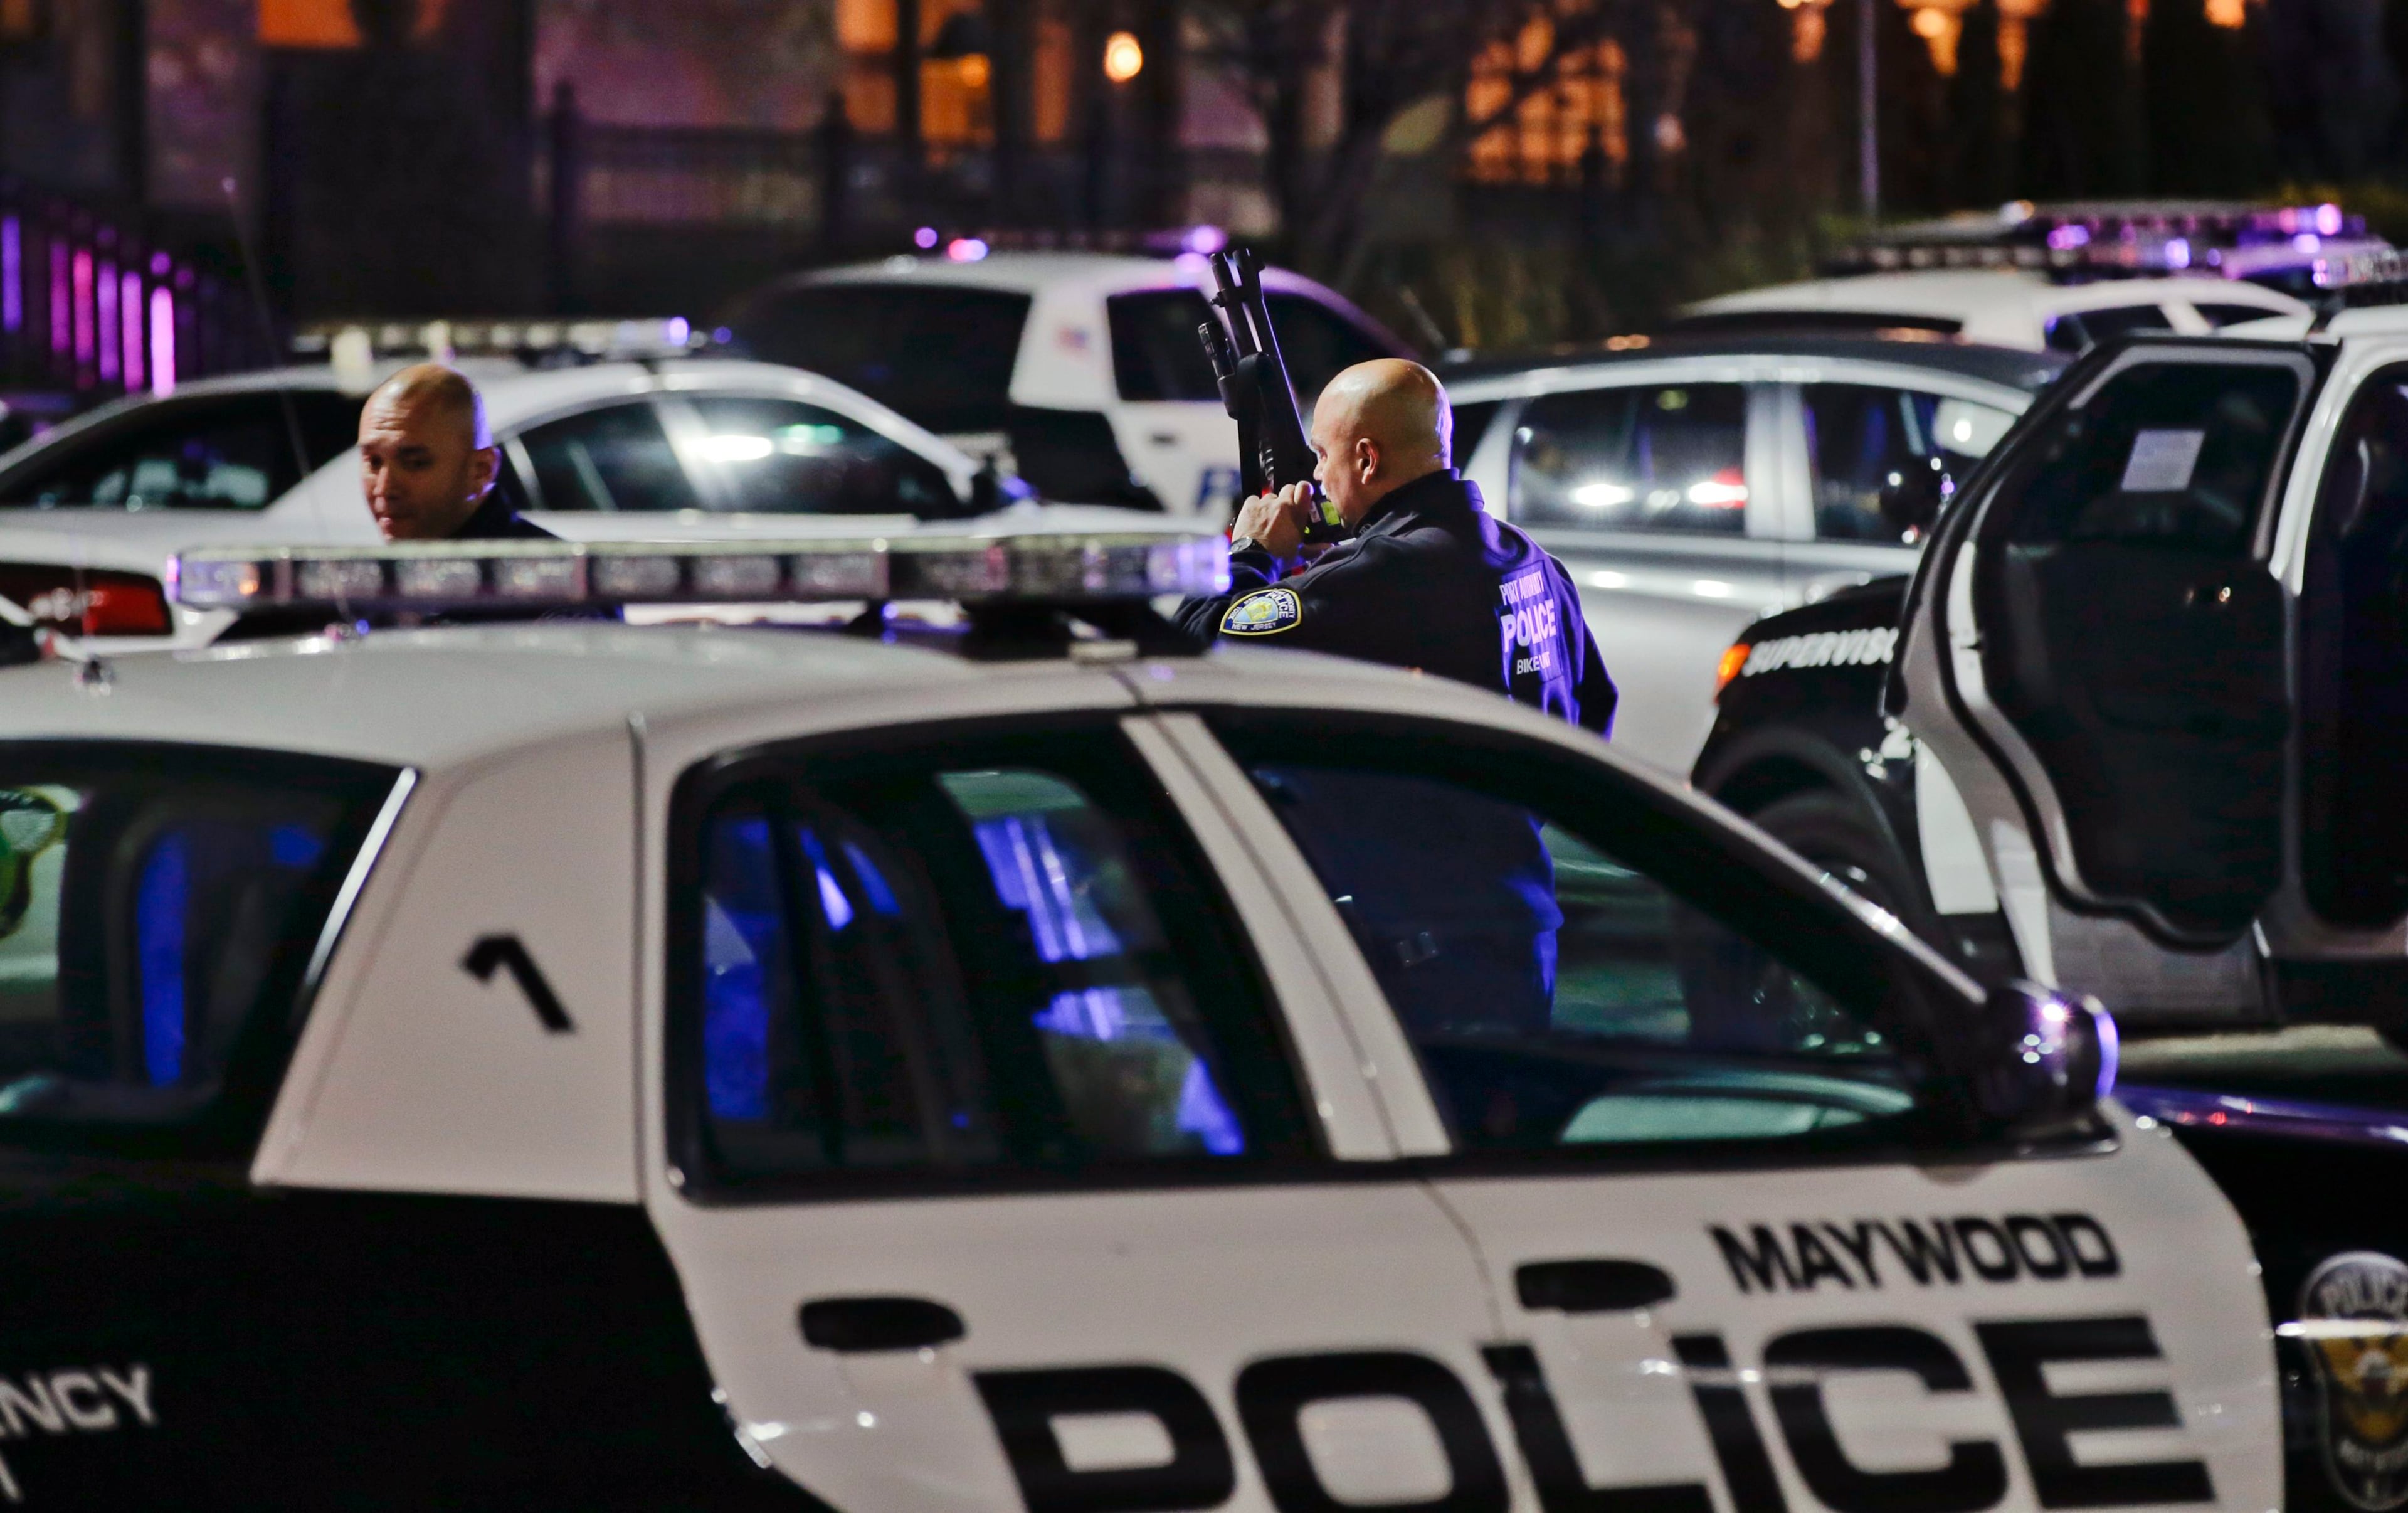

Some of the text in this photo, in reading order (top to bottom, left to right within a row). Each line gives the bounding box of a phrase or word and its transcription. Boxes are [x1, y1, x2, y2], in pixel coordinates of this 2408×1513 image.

[1499, 580, 1519, 605] PORT
[1500, 598, 1556, 653] POLICE
[1516, 656, 1540, 675] BIKE
[1708, 1211, 2122, 1293] MAYWOOD
[0, 1365, 155, 1436] NCY
[970, 1314, 2217, 1513] POLICE
